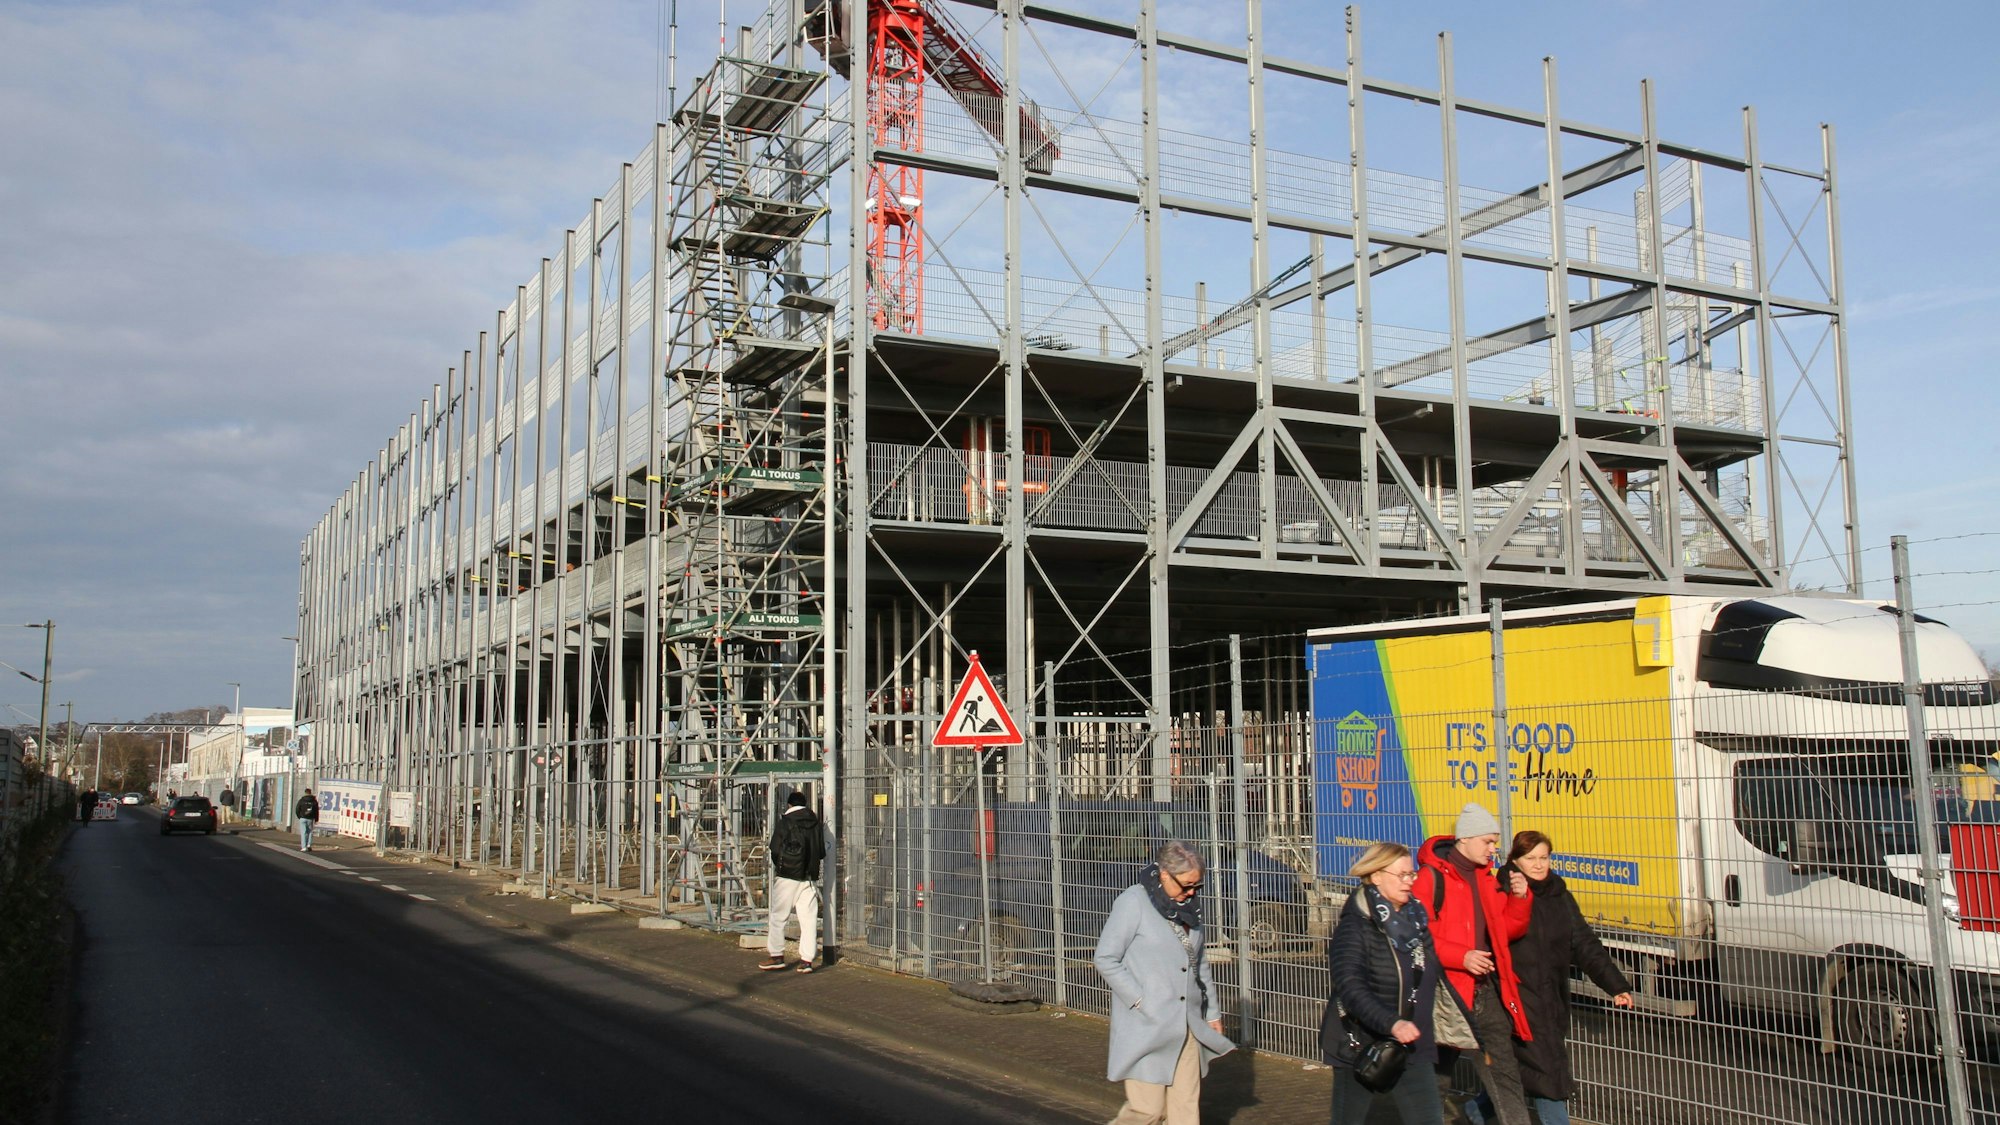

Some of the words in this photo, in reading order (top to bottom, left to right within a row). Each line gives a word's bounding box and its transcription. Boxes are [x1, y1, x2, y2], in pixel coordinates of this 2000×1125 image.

[750, 469, 766, 478] ALI
[768, 470, 801, 480] TOKUS
[749, 615, 765, 623] ALI
[767, 615, 800, 624] TOKUS
[1337, 731, 1376, 756] HOME
[1446, 722, 1487, 752] IT'S
[1341, 757, 1376, 782] SHOP
[1447, 760, 1479, 790] TO
[1523, 751, 1598, 802] Home
[1565, 860, 1577, 873] 65
[1579, 862, 1592, 875] 68
[1594, 863, 1607, 876] 62
[1609, 865, 1630, 879] 640
